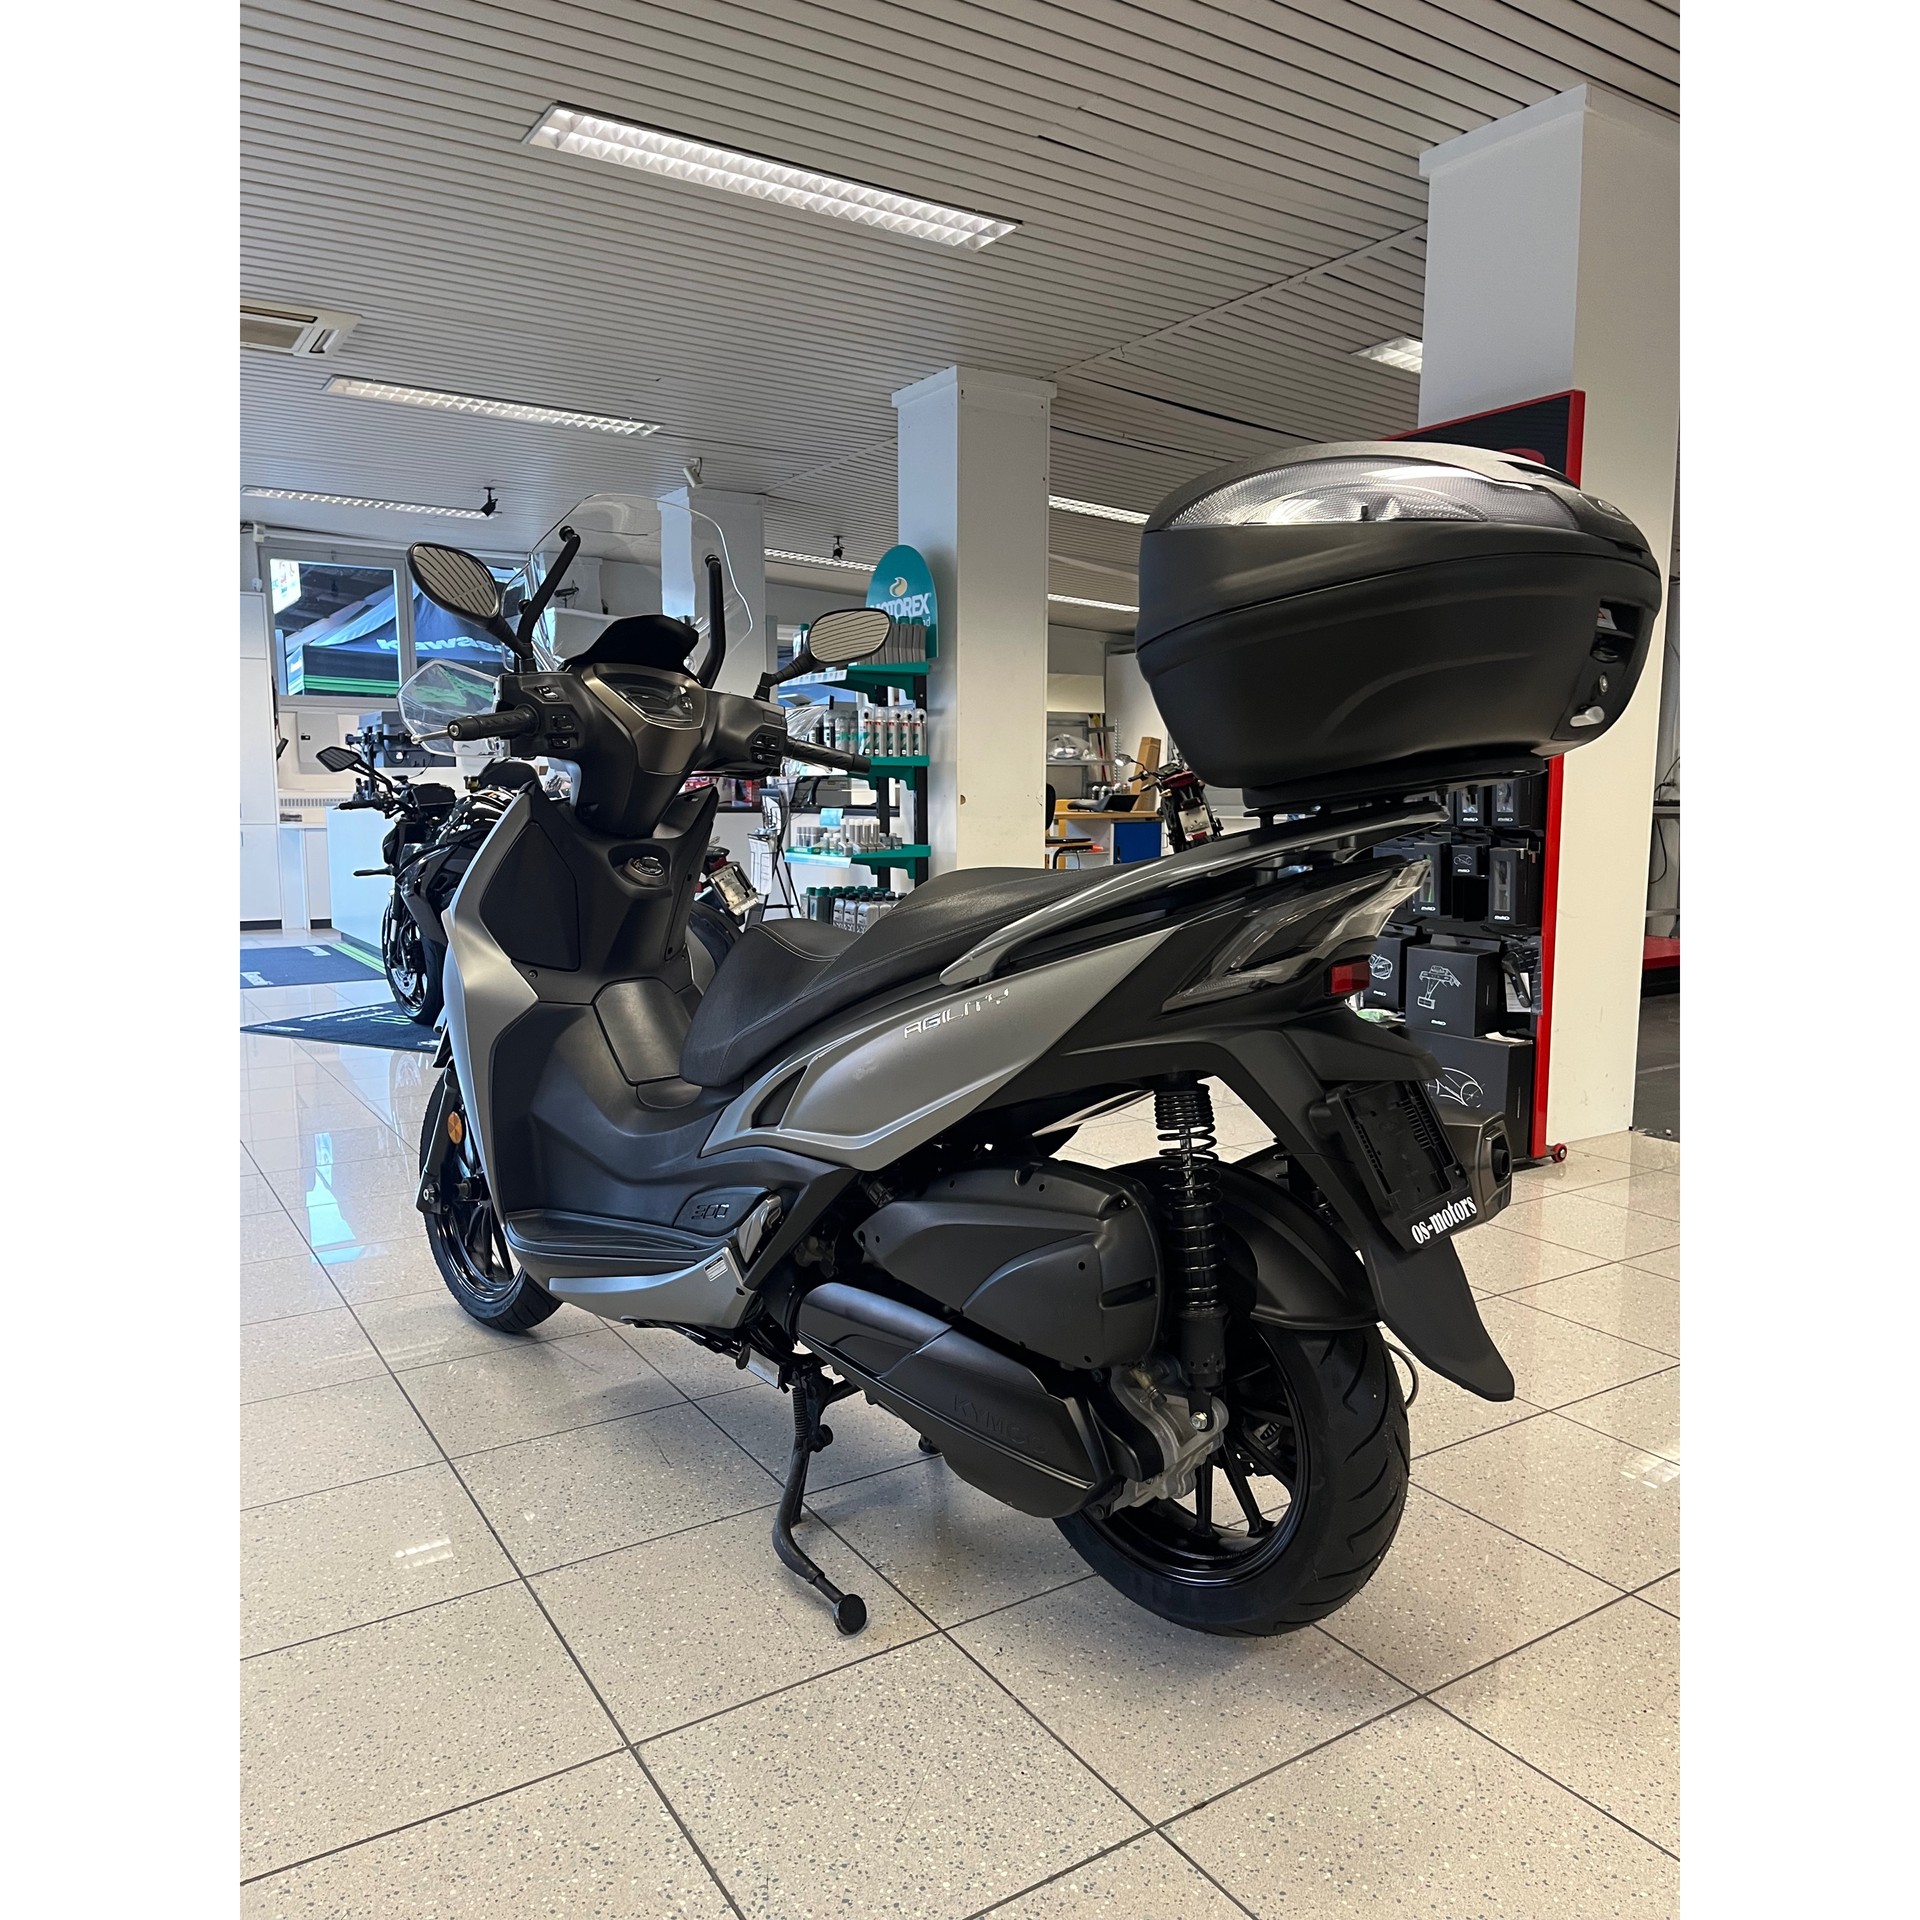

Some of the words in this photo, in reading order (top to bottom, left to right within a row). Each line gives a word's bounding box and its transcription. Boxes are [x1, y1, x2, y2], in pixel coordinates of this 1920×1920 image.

[867, 593, 931, 618] OTOREX
[904, 988, 1009, 1039] AGILITY
[691, 1203, 730, 1220] 300
[1411, 1196, 1477, 1244] os-motors
[954, 1394, 1048, 1456] KYMCO
